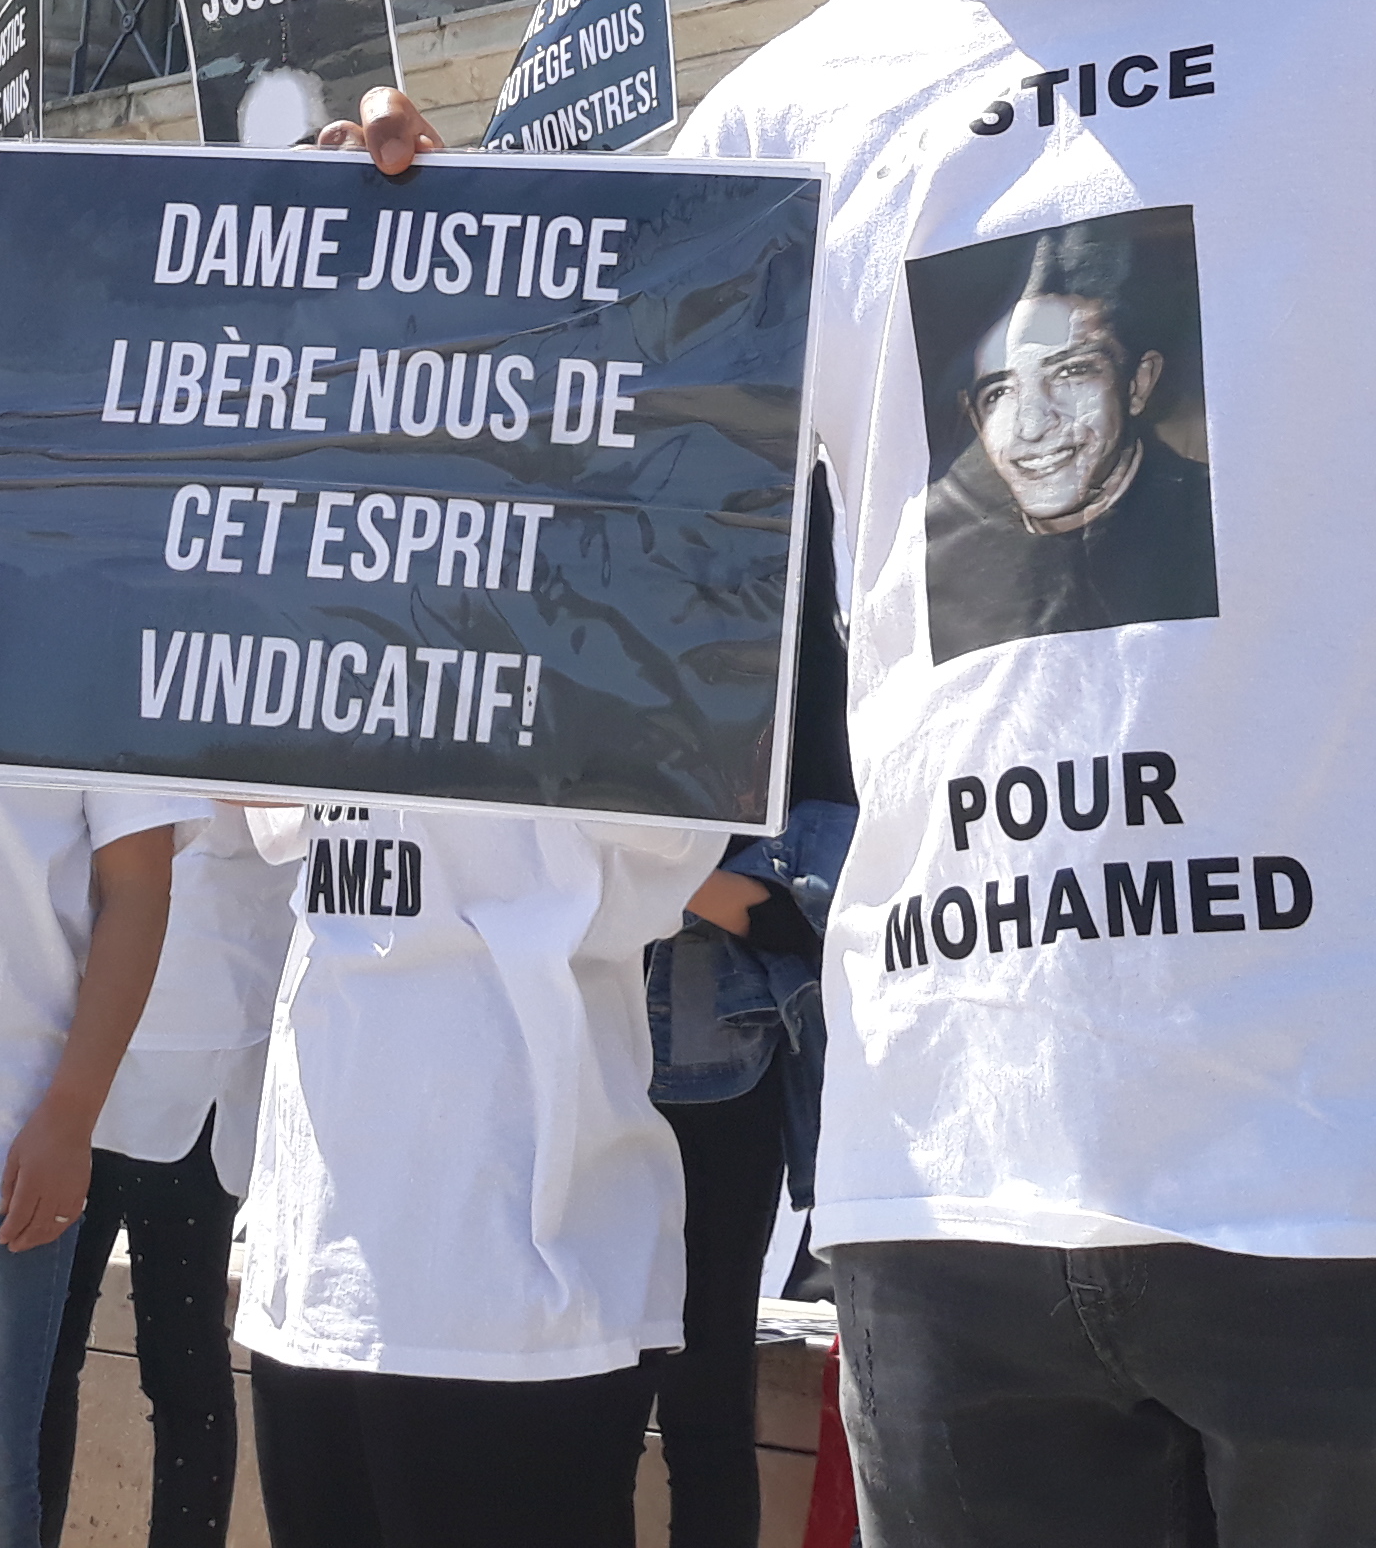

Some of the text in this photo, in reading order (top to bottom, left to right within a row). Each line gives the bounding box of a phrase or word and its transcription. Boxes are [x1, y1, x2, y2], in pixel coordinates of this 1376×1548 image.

[579, 2, 645, 70] NOUS
[2, 69, 30, 128] NOUS
[521, 65, 659, 152] MONSTRES!
[154, 202, 628, 302] DAME JUSTICE
[101, 326, 644, 448] LIBÈRE NOUS DE
[164, 483, 555, 592] CET ESPRIT
[139, 628, 543, 747] VINDICATIF!
[947, 751, 1183, 852] POUR
[885, 855, 1313, 972] MOHAMED
